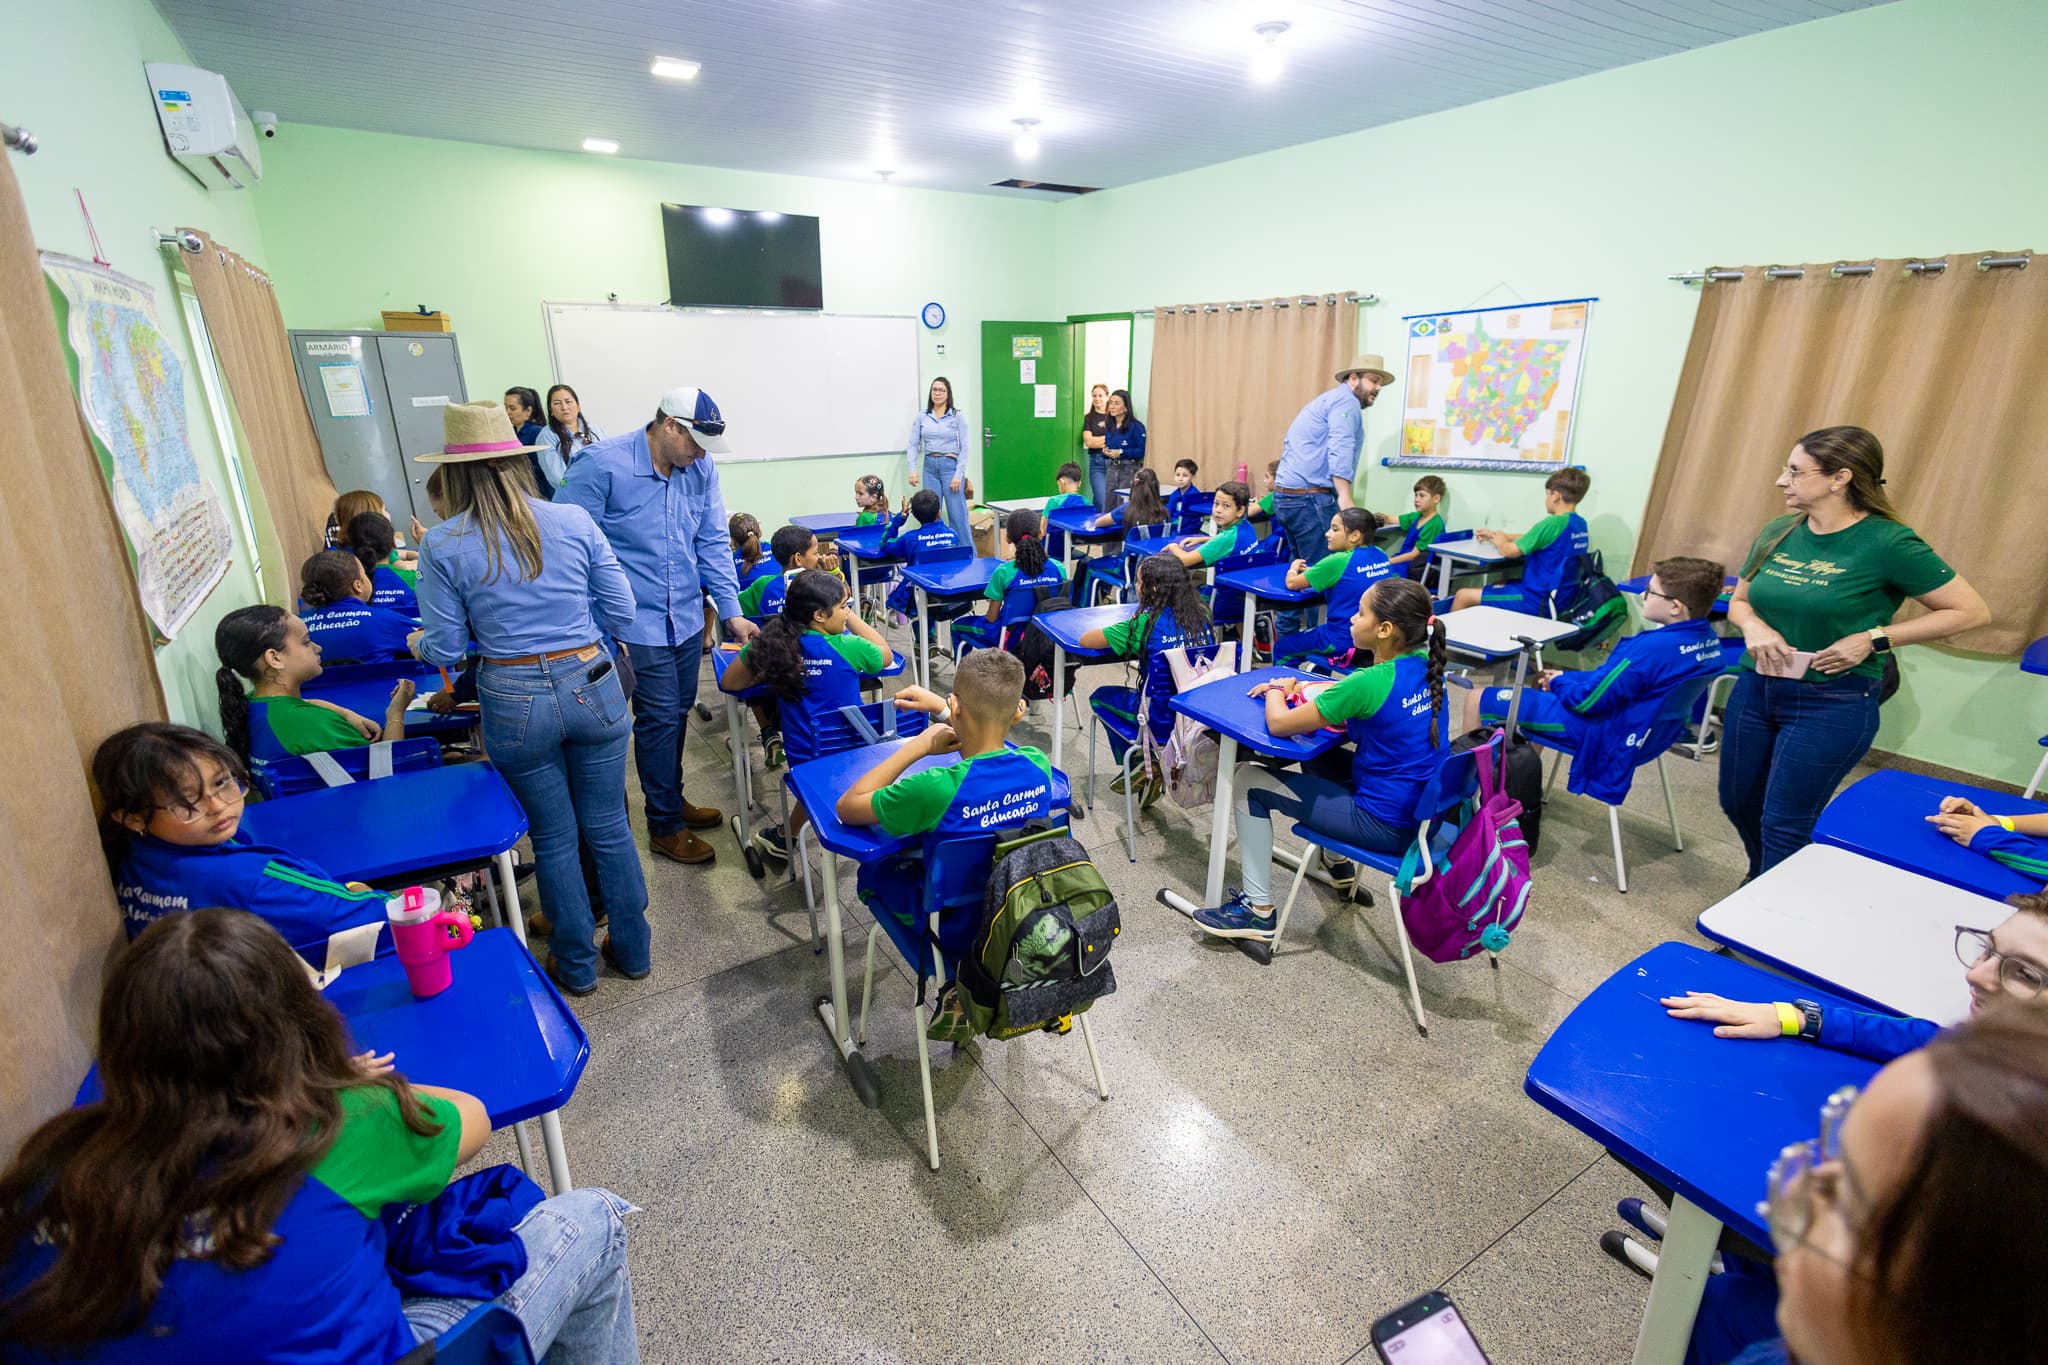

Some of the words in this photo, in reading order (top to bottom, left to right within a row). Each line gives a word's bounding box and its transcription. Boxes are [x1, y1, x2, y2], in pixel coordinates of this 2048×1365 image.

[301, 612, 324, 623] anta
[326, 610, 372, 619] Carmem
[308, 618, 361, 632] Educação
[962, 799, 1000, 819] Santa
[1002, 784, 1046, 806] Carmem
[980, 801, 1039, 828] Educação
